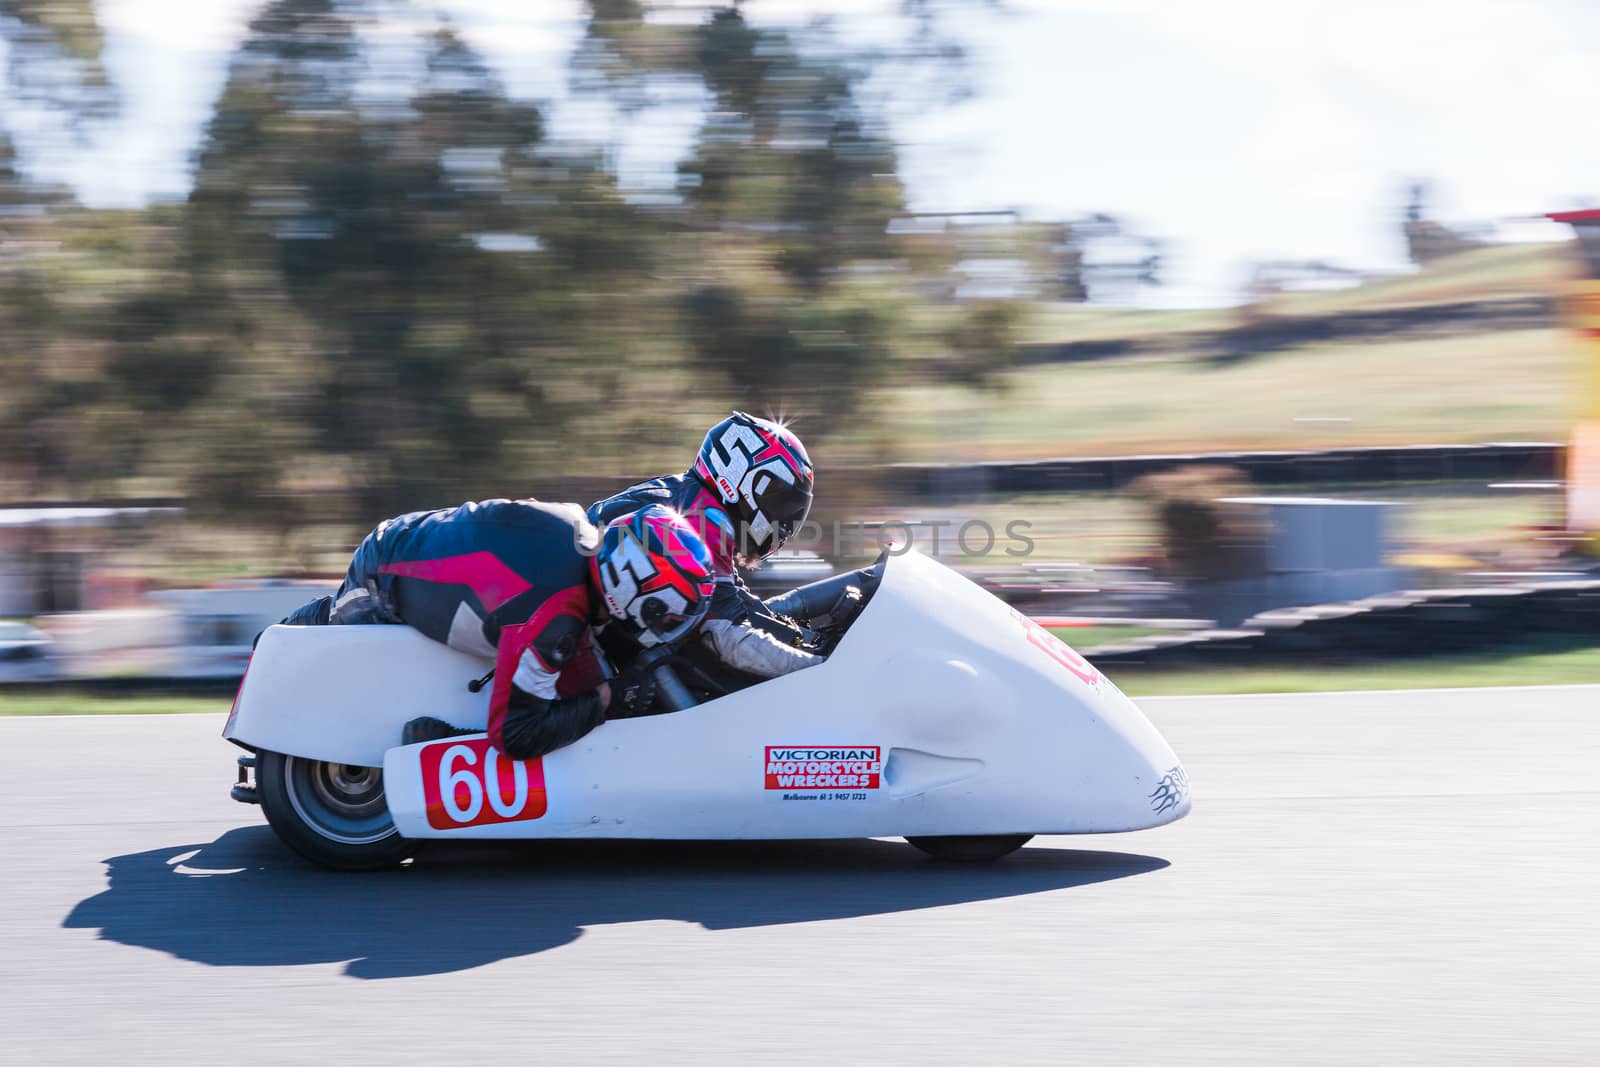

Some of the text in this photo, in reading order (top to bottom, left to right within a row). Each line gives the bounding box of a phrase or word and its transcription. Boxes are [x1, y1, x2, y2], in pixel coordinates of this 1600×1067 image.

[719, 478, 735, 499] BELL
[772, 750, 875, 760] VICTORIAN
[766, 762, 880, 775] MOTORCYCLE
[438, 744, 528, 823] 60
[777, 774, 870, 787] WRECKERS
